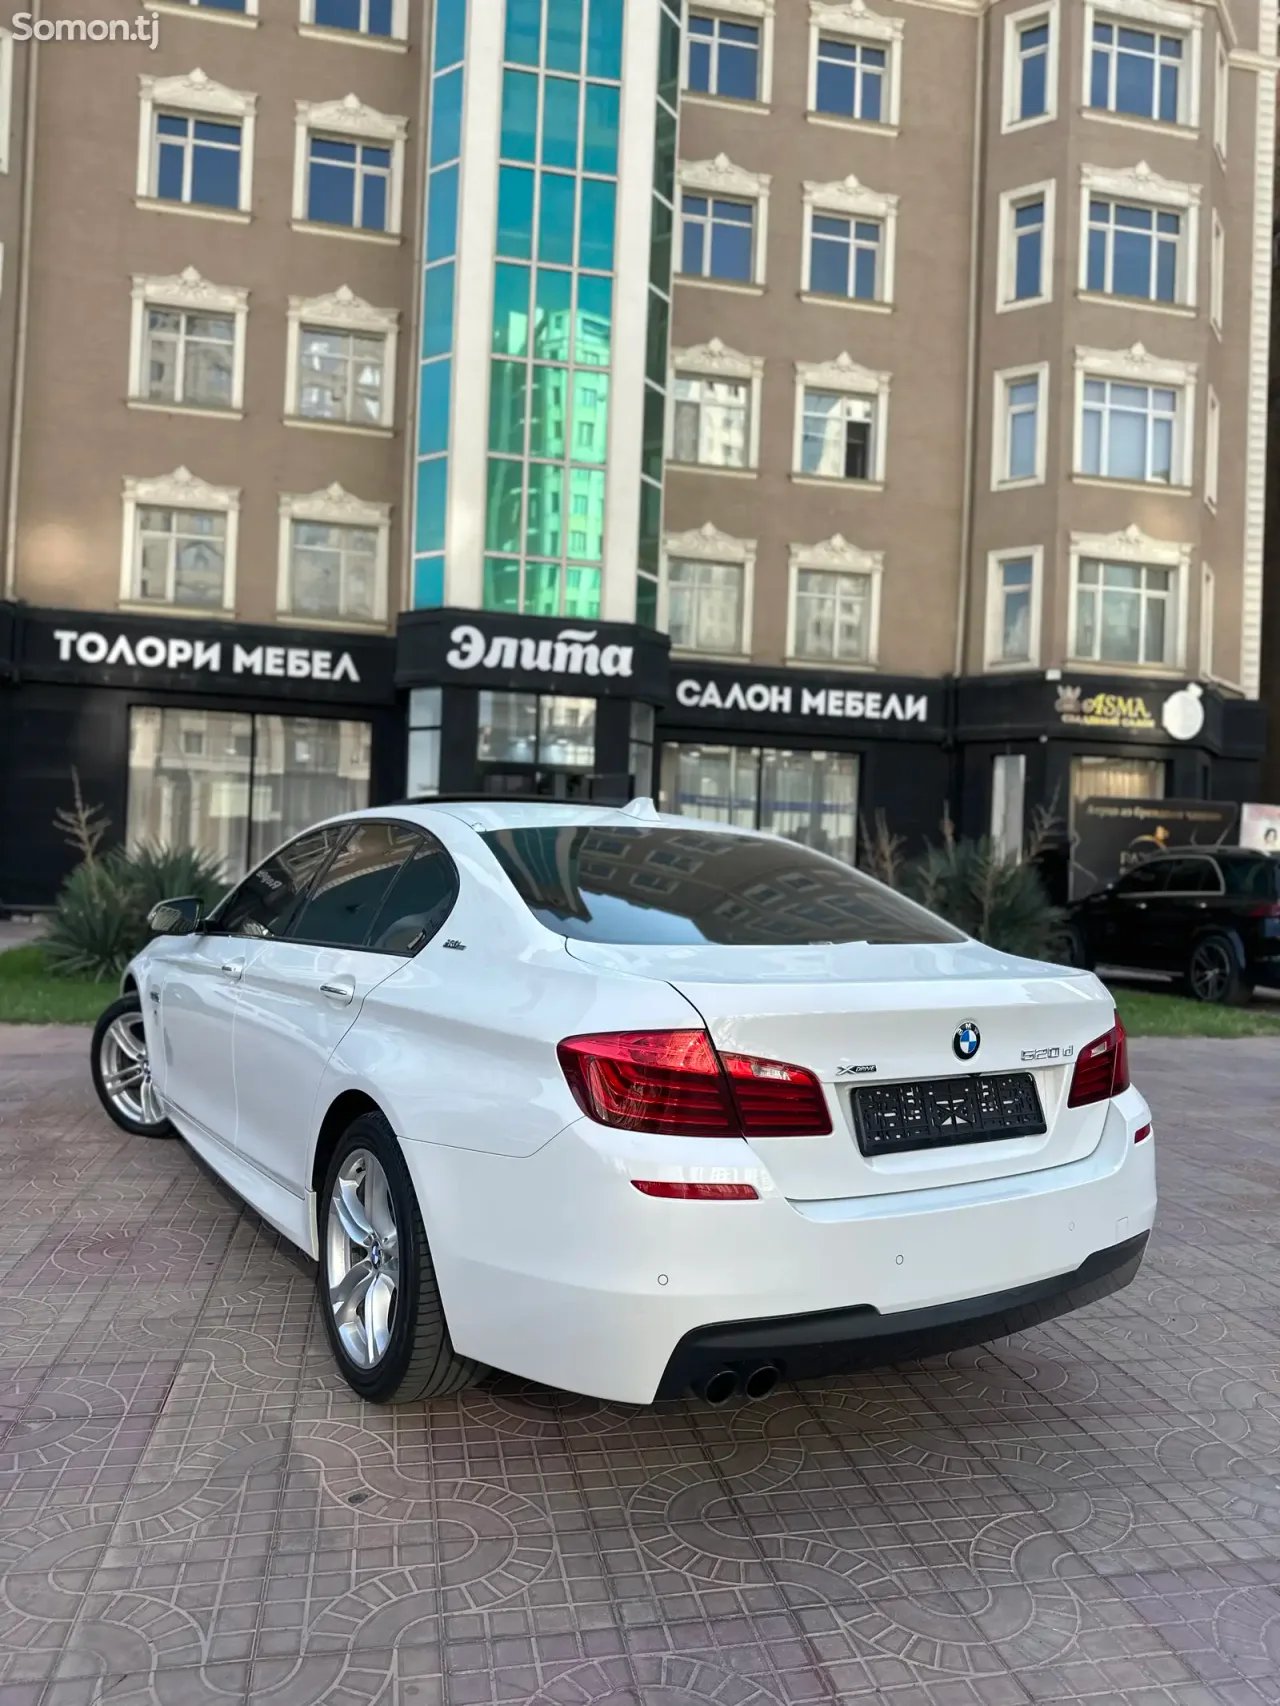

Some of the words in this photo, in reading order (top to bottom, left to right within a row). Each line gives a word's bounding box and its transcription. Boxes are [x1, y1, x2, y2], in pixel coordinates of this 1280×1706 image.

[54, 630, 221, 672] ТОЛОРИ
[233, 644, 360, 682] МЕБЕЛ
[446, 625, 634, 677] Элита
[676, 679, 792, 715] САЛОН
[801, 688, 928, 723] МЕБЕЛИ
